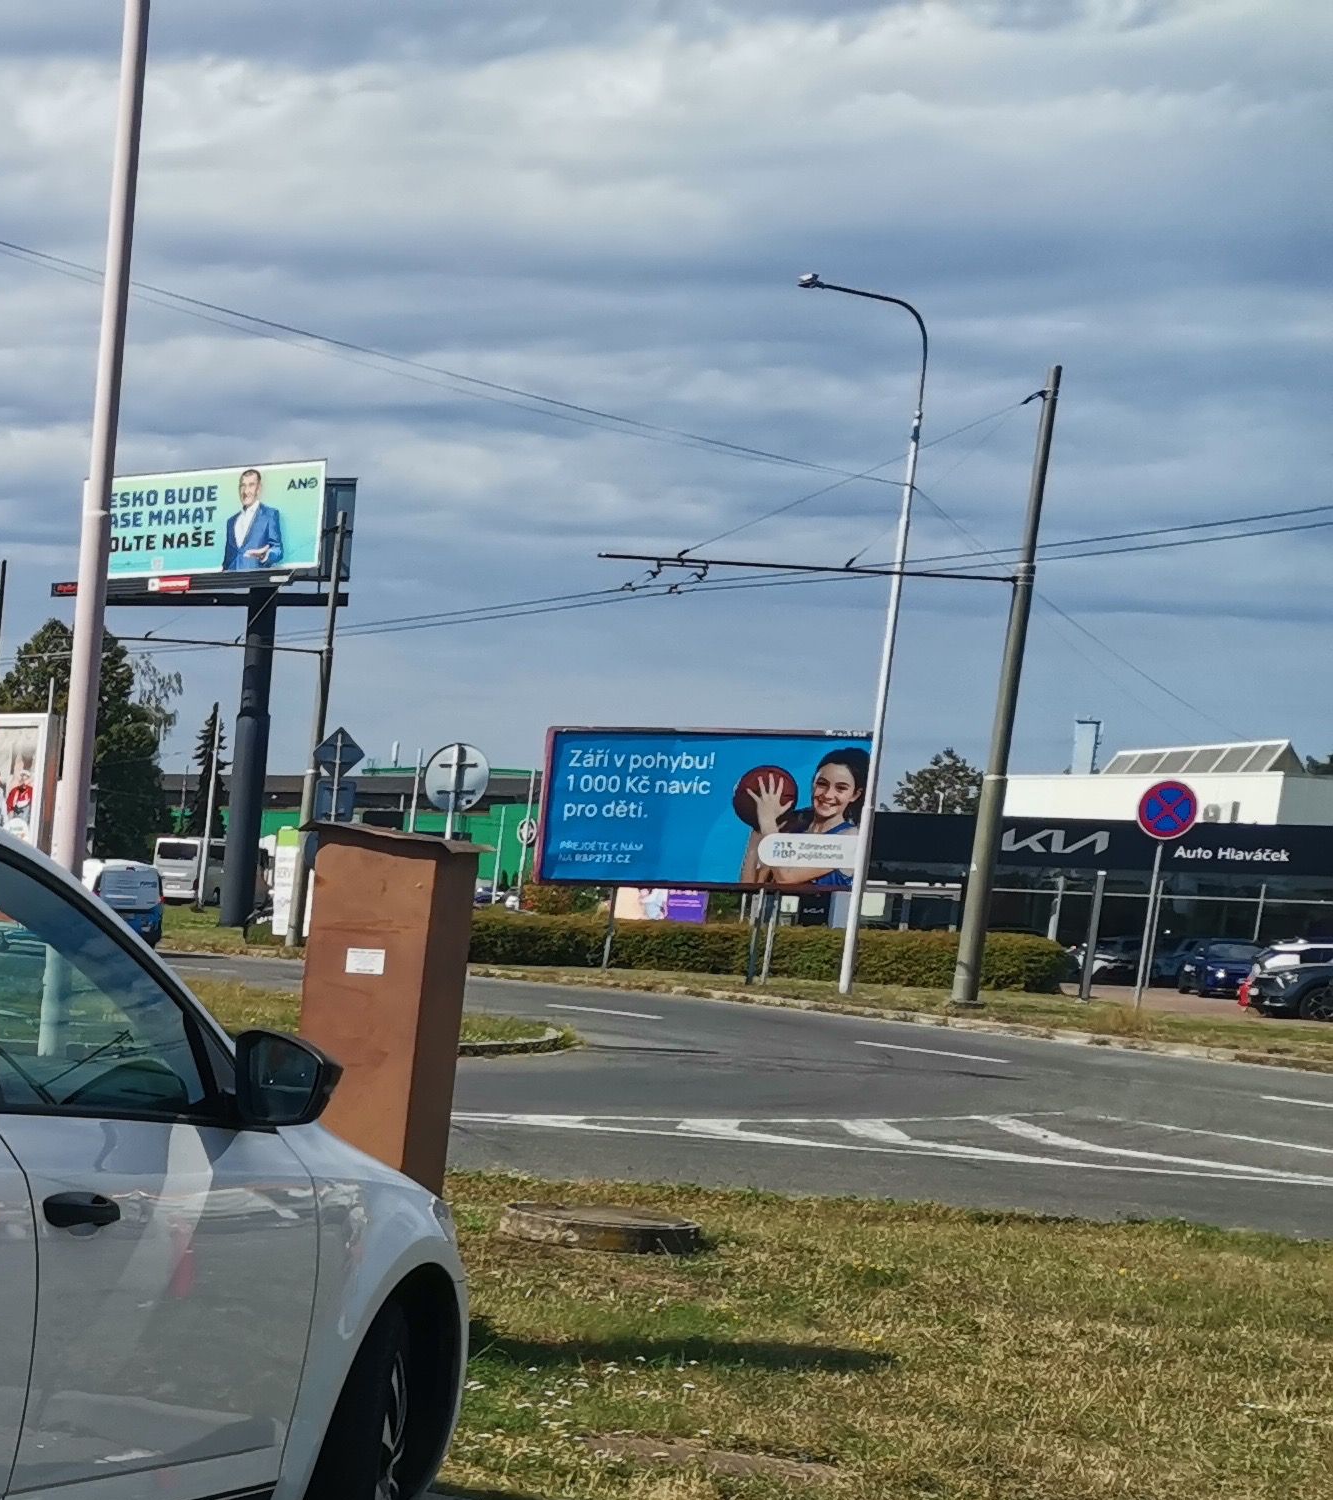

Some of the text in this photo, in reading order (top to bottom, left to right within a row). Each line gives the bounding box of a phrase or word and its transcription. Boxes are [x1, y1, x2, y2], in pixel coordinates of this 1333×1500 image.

[287, 477, 318, 491] ANO
[110, 485, 218, 509] ESKO BUDE
[110, 506, 217, 529] ASE MAKAT
[110, 525, 216, 553] OLTE NAŠE
[569, 747, 715, 774] Září v pohybu!
[625, 775, 650, 794] Kč
[654, 776, 711, 795] navíc
[563, 802, 598, 821] pro
[1173, 845, 1290, 862] Auto Hlaváček
